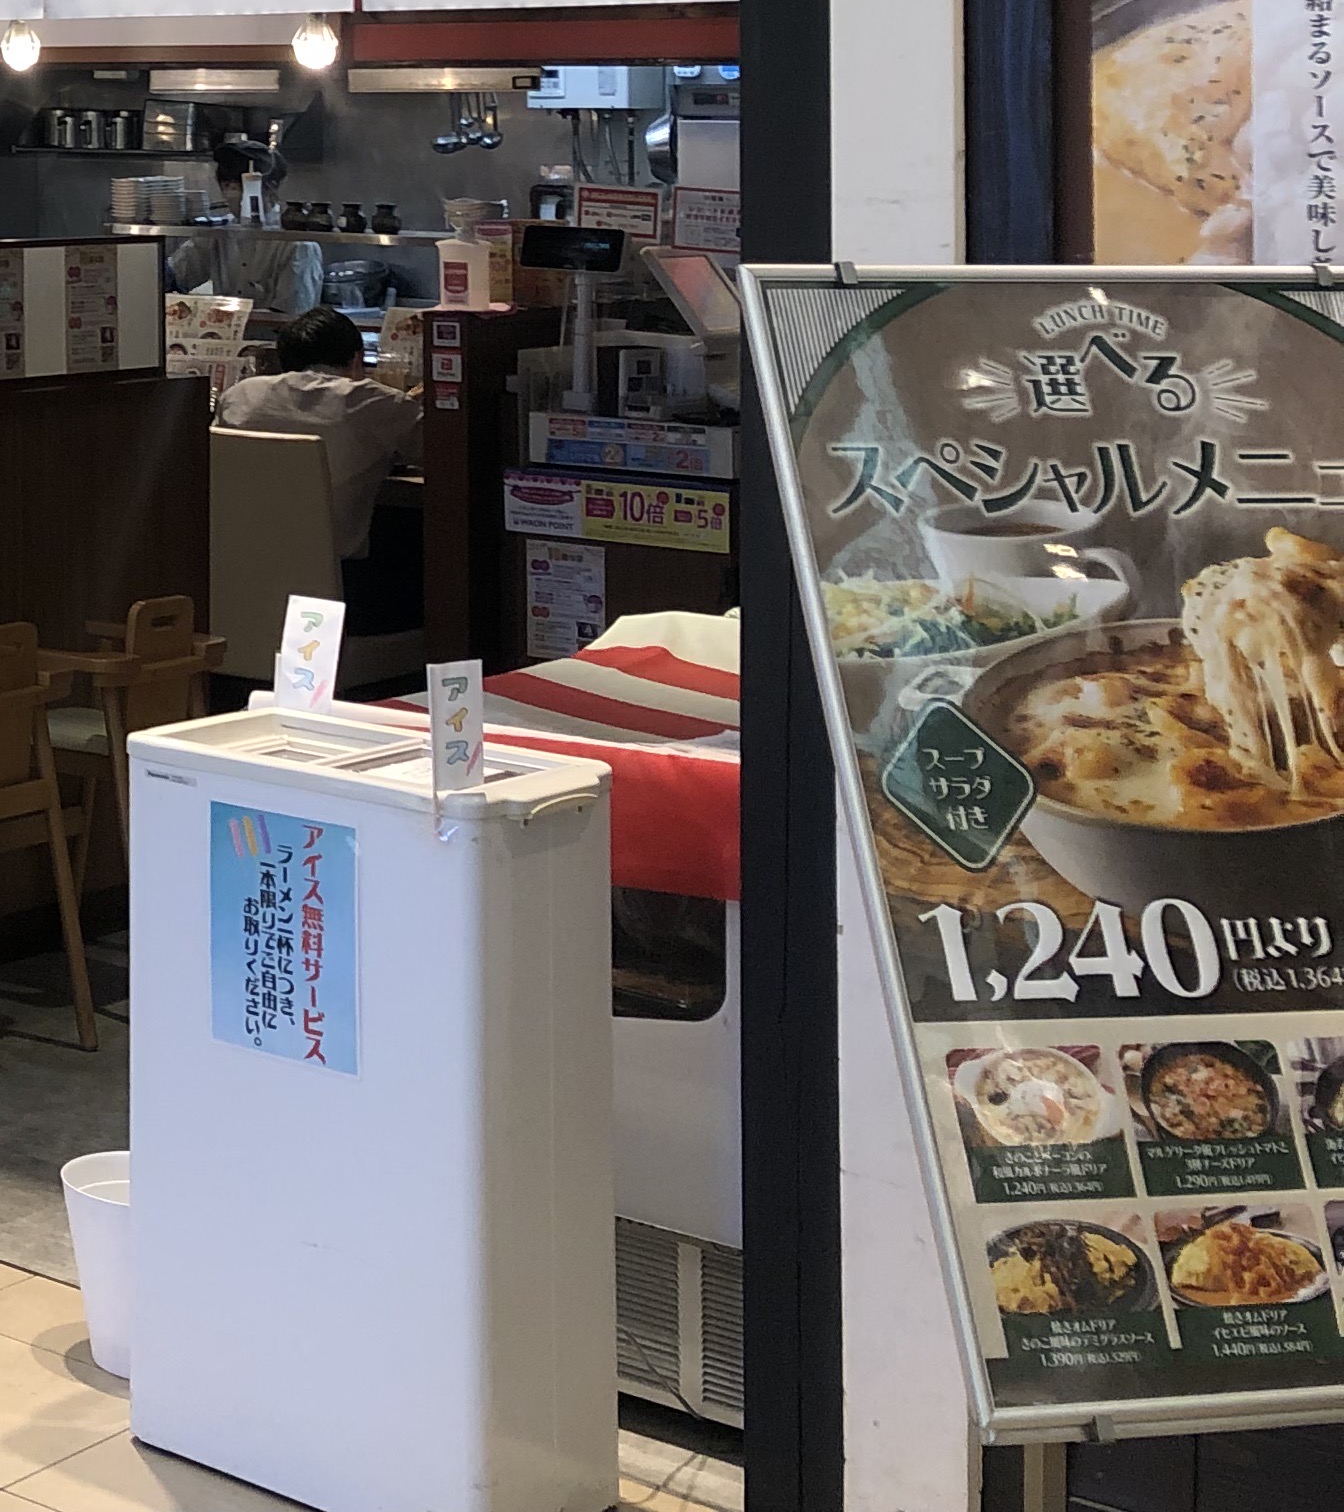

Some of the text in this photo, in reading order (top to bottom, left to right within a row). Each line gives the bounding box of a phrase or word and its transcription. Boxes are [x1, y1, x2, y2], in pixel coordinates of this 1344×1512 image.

[1038, 304, 1165, 337] LUNCH TIME
[1022, 331, 1197, 413] 選べる
[619, 490, 667, 526] 10倍
[696, 509, 723, 531] 5倍
[290, 610, 325, 692] アイス
[441, 675, 470, 766] アイス
[921, 747, 986, 770] スープ
[928, 775, 993, 801] サラダ
[946, 804, 990, 832] 付き
[242, 896, 262, 1047] お取りください。
[259, 860, 278, 1031] 一本限りでご自由に
[276, 844, 296, 1026] ラーメン一杯につき、
[301, 824, 327, 1065] アイス無料サービス
